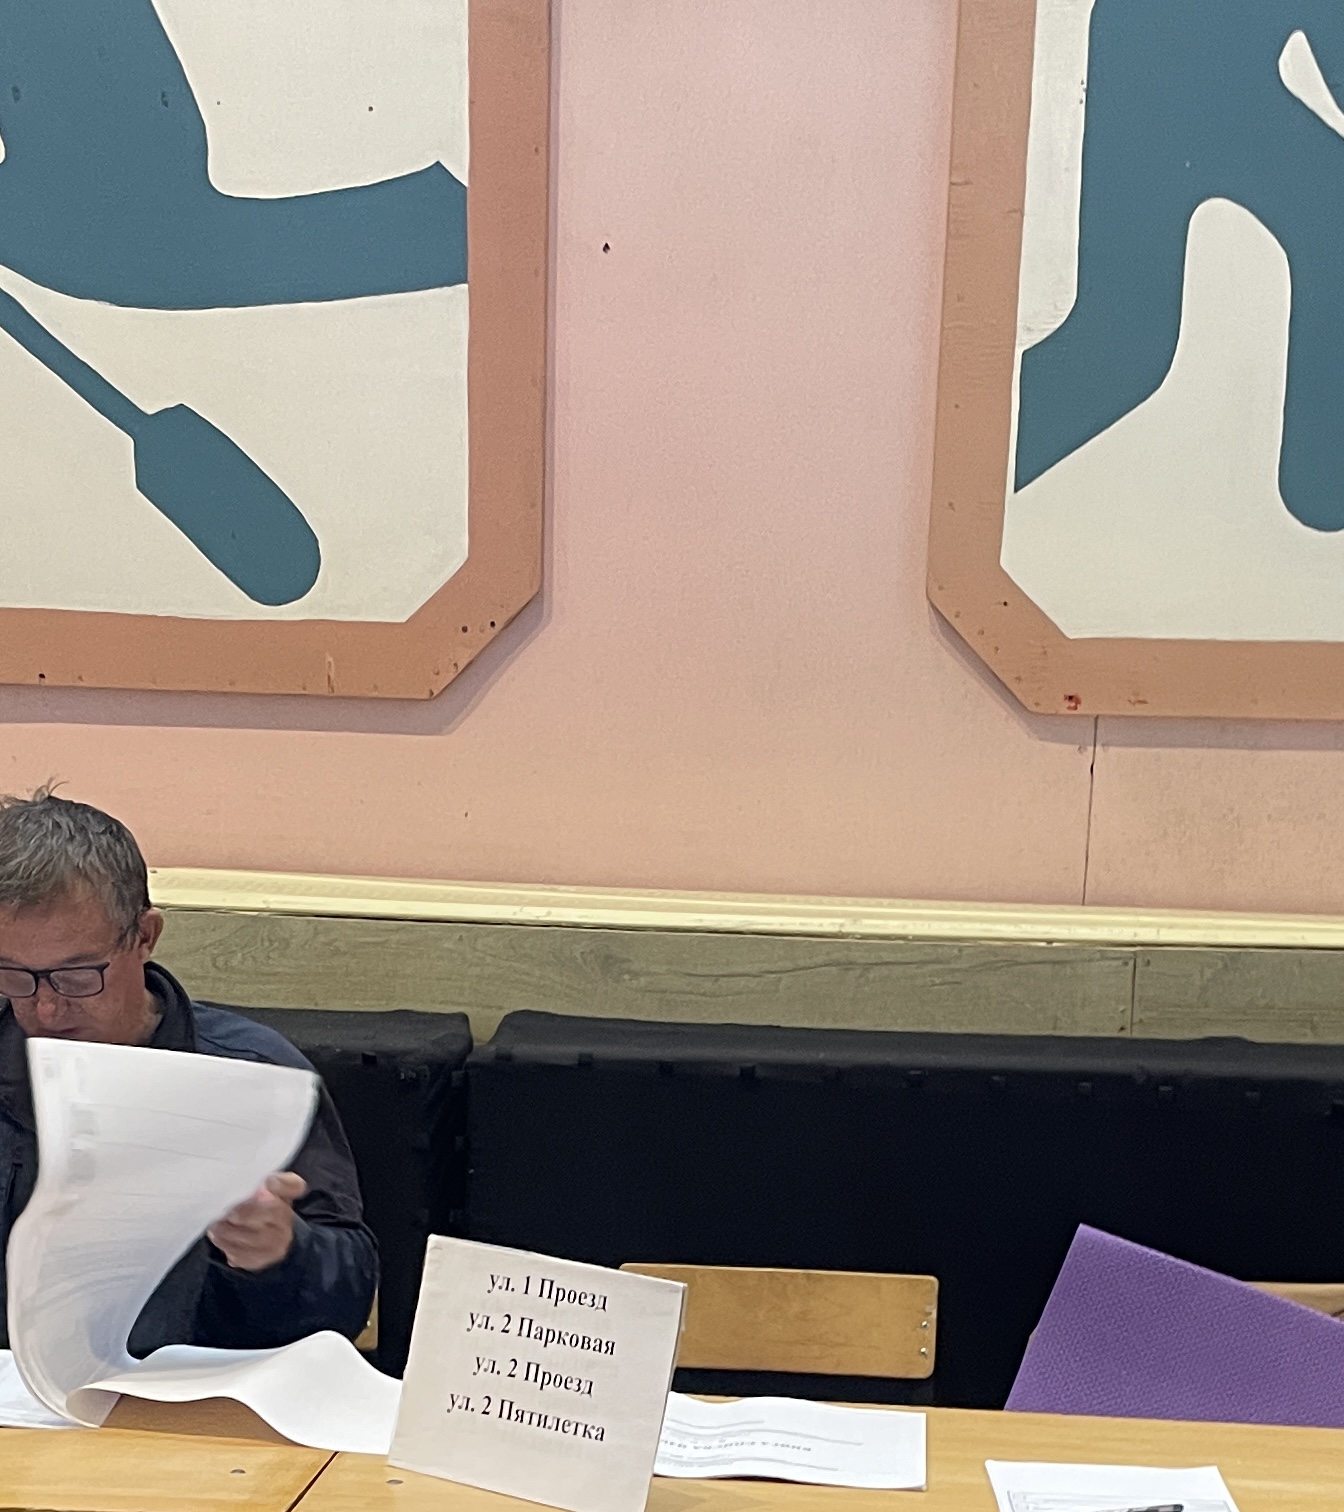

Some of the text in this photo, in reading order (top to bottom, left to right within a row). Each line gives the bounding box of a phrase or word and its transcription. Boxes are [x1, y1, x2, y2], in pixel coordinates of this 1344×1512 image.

[486, 1273, 608, 1312] ул. 1 Проезд
[466, 1311, 616, 1356] ул. 2 Парковая
[472, 1355, 594, 1397] ул. 2 Проезд
[446, 1392, 606, 1442] ул. 2 Пятилетка
